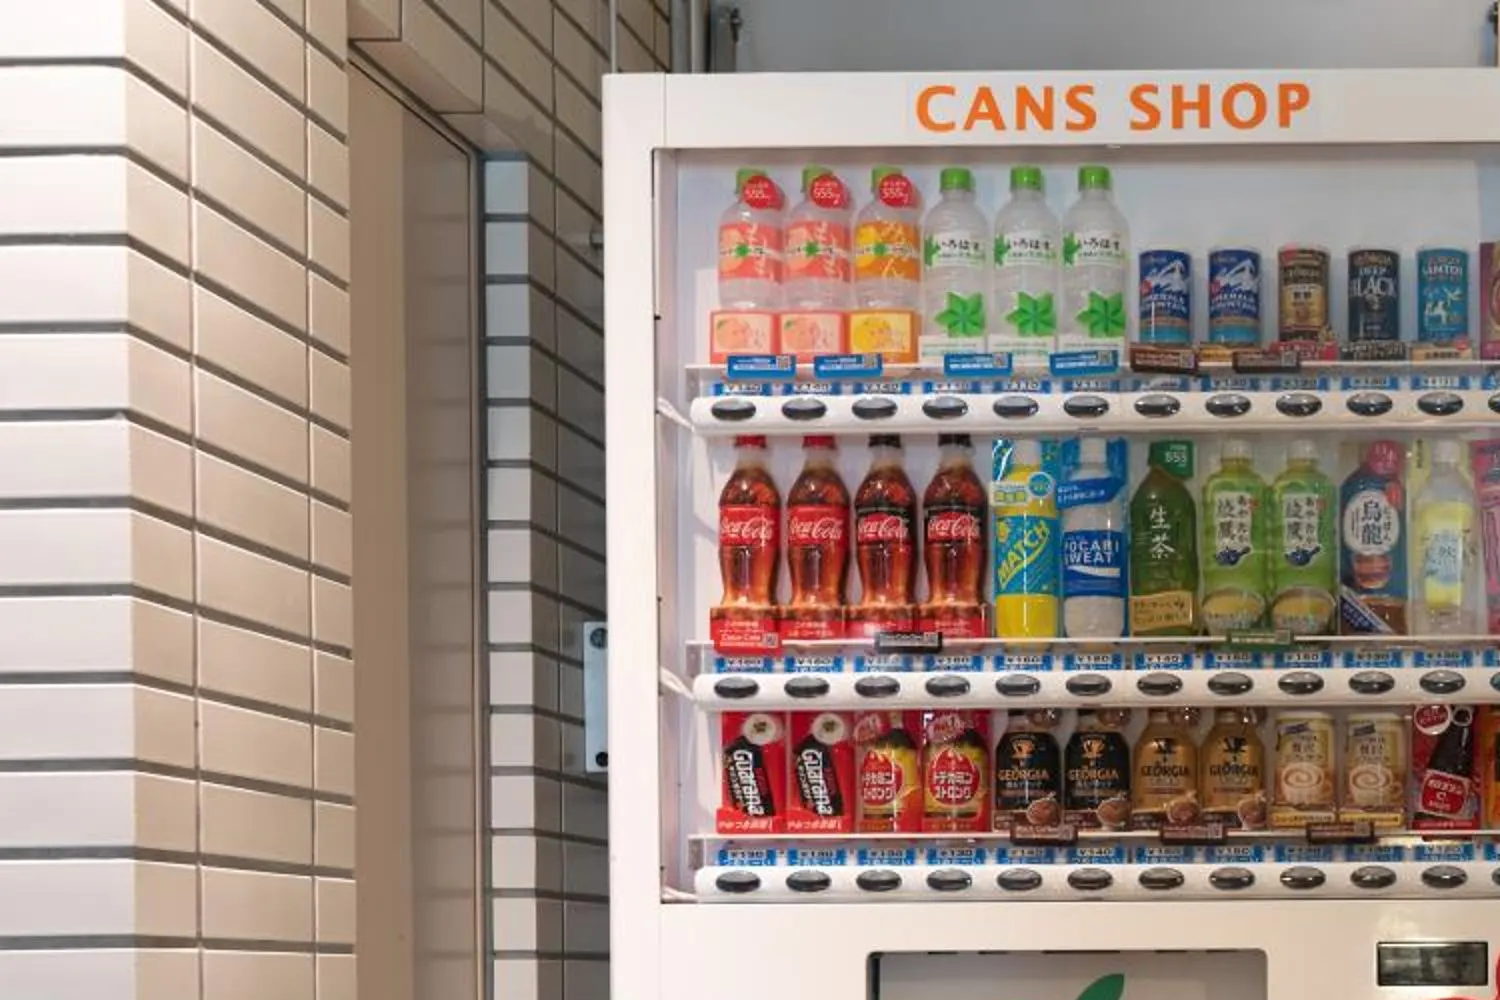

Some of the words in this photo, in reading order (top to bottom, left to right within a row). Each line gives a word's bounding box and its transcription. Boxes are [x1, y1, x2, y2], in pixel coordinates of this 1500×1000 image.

[916, 84, 1098, 132] CANS
[1129, 82, 1311, 131] SHOP
[1149, 505, 1175, 559] 生茶
[998, 519, 1049, 585] MATCH
[997, 767, 1050, 781] GEORGIA
[1067, 767, 1120, 781] GEORGIA
[1140, 762, 1191, 777] GEORGIA
[1209, 762, 1259, 777] GEORGIA
